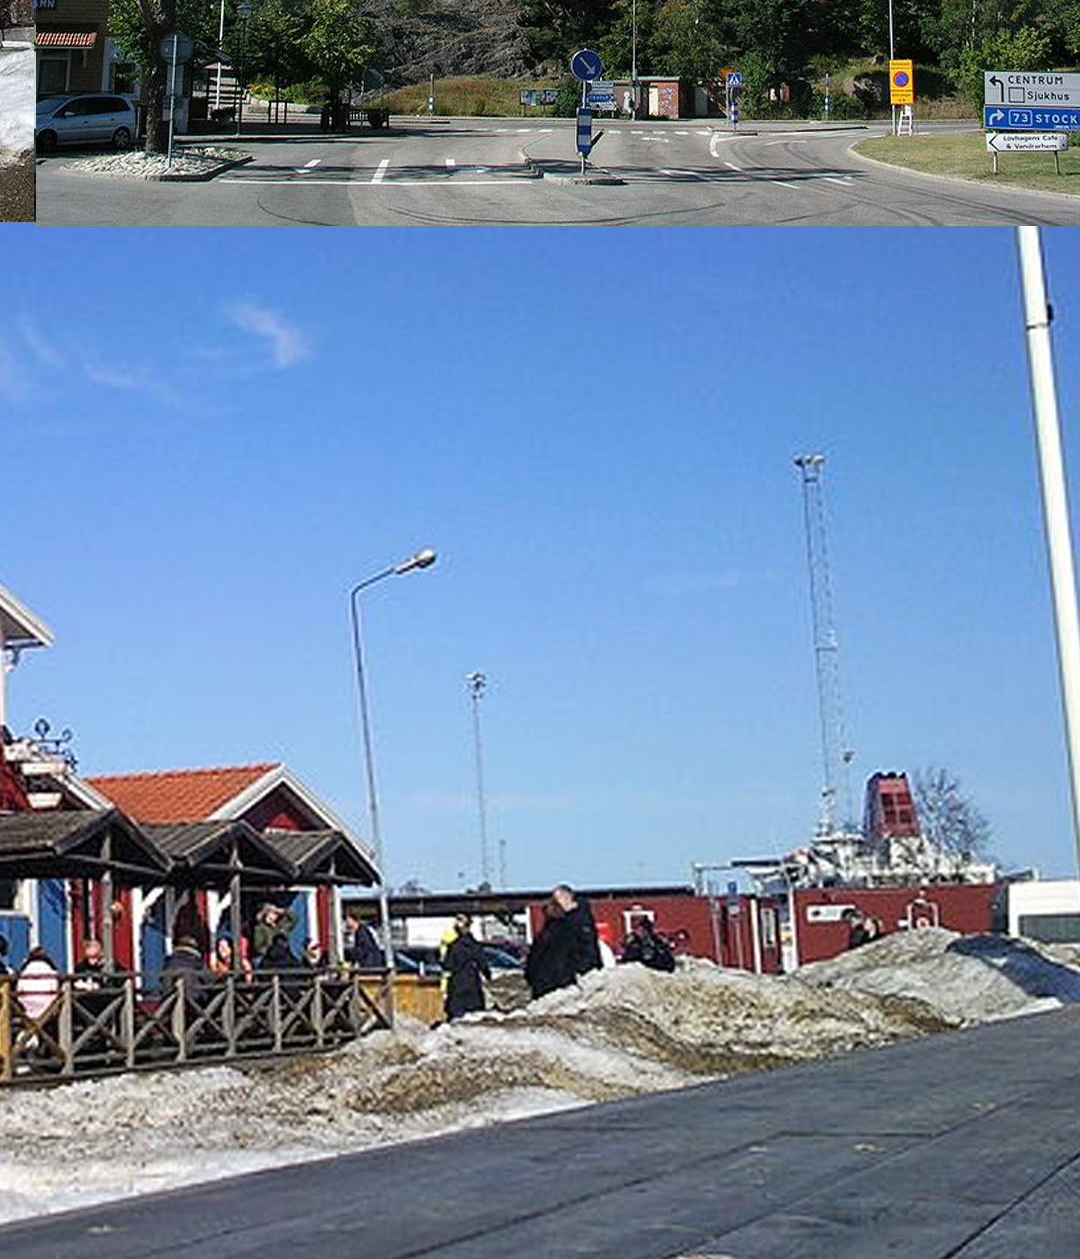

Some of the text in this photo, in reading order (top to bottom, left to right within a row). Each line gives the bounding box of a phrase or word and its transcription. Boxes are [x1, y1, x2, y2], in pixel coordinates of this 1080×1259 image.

[1007, 75, 1064, 85] CENTRUM
[1027, 91, 1070, 101] Sjukhus
[1012, 113, 1080, 124] 73 STOCK
